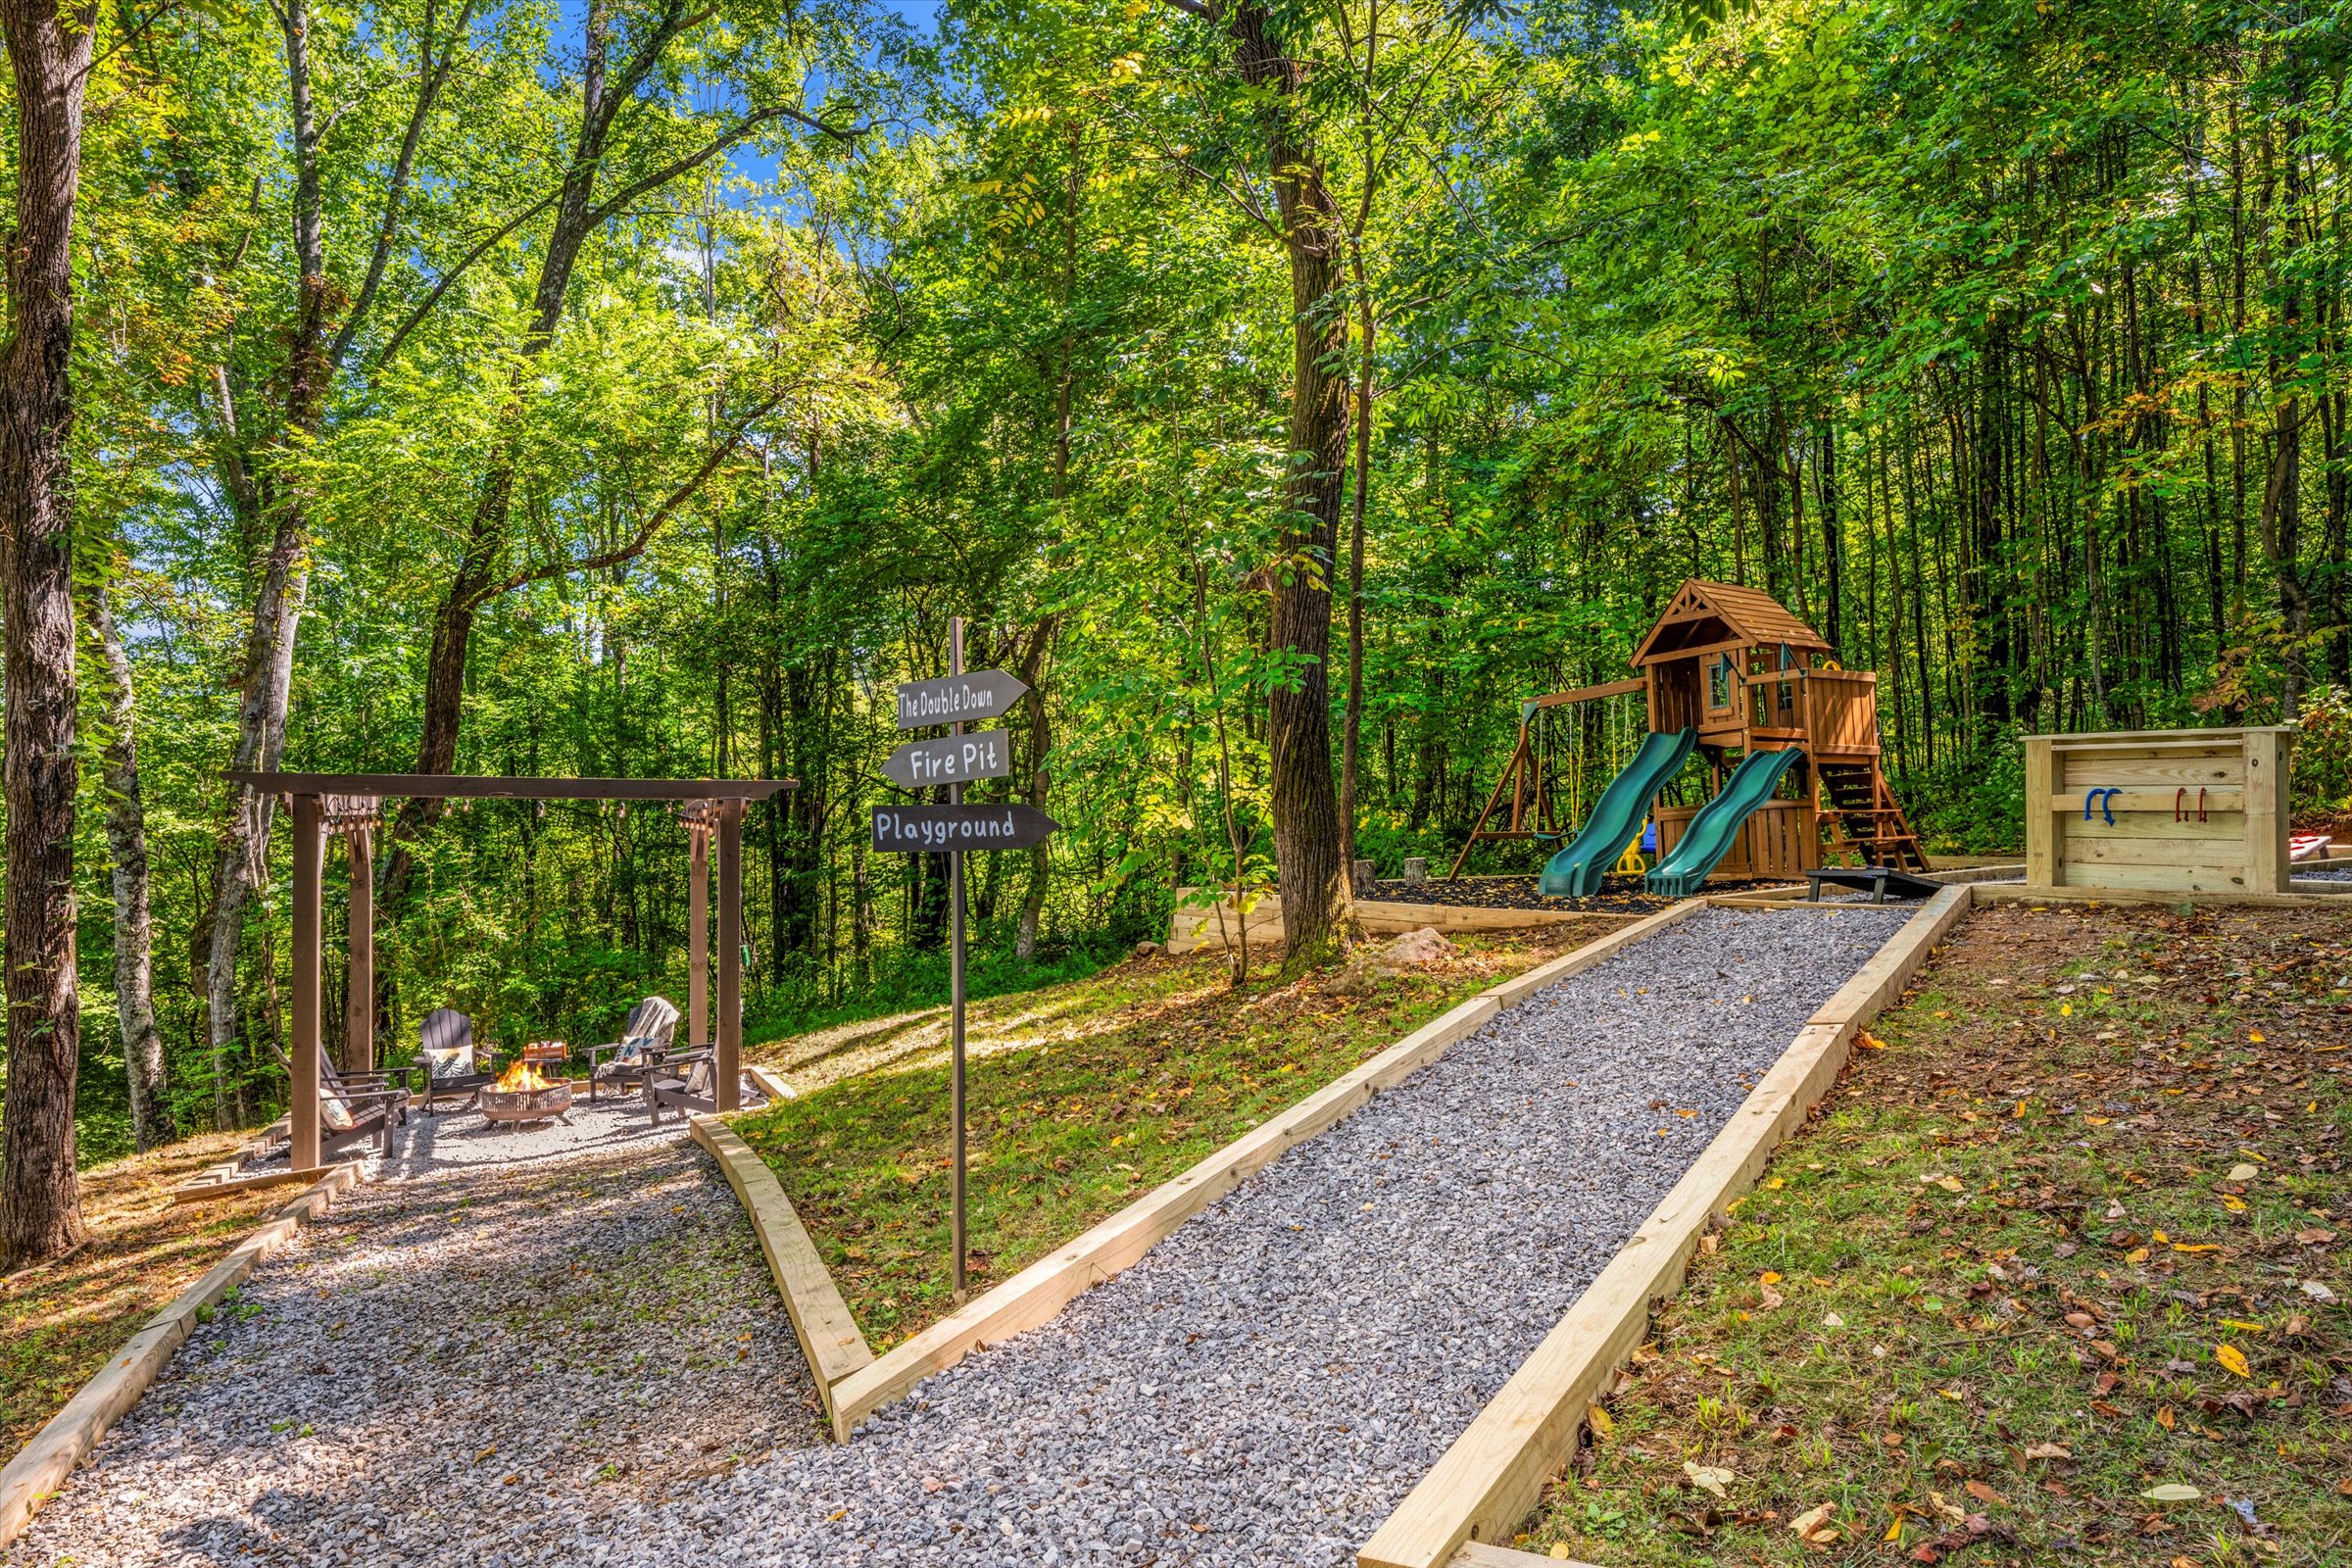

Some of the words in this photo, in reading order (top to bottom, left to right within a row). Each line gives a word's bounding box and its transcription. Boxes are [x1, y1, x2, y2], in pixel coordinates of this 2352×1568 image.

[898, 692, 918, 719] The
[920, 686, 960, 717] Double
[962, 684, 993, 710] Down
[910, 750, 956, 780] Fire
[962, 741, 998, 774] Pit
[876, 809, 1015, 845] Playground
